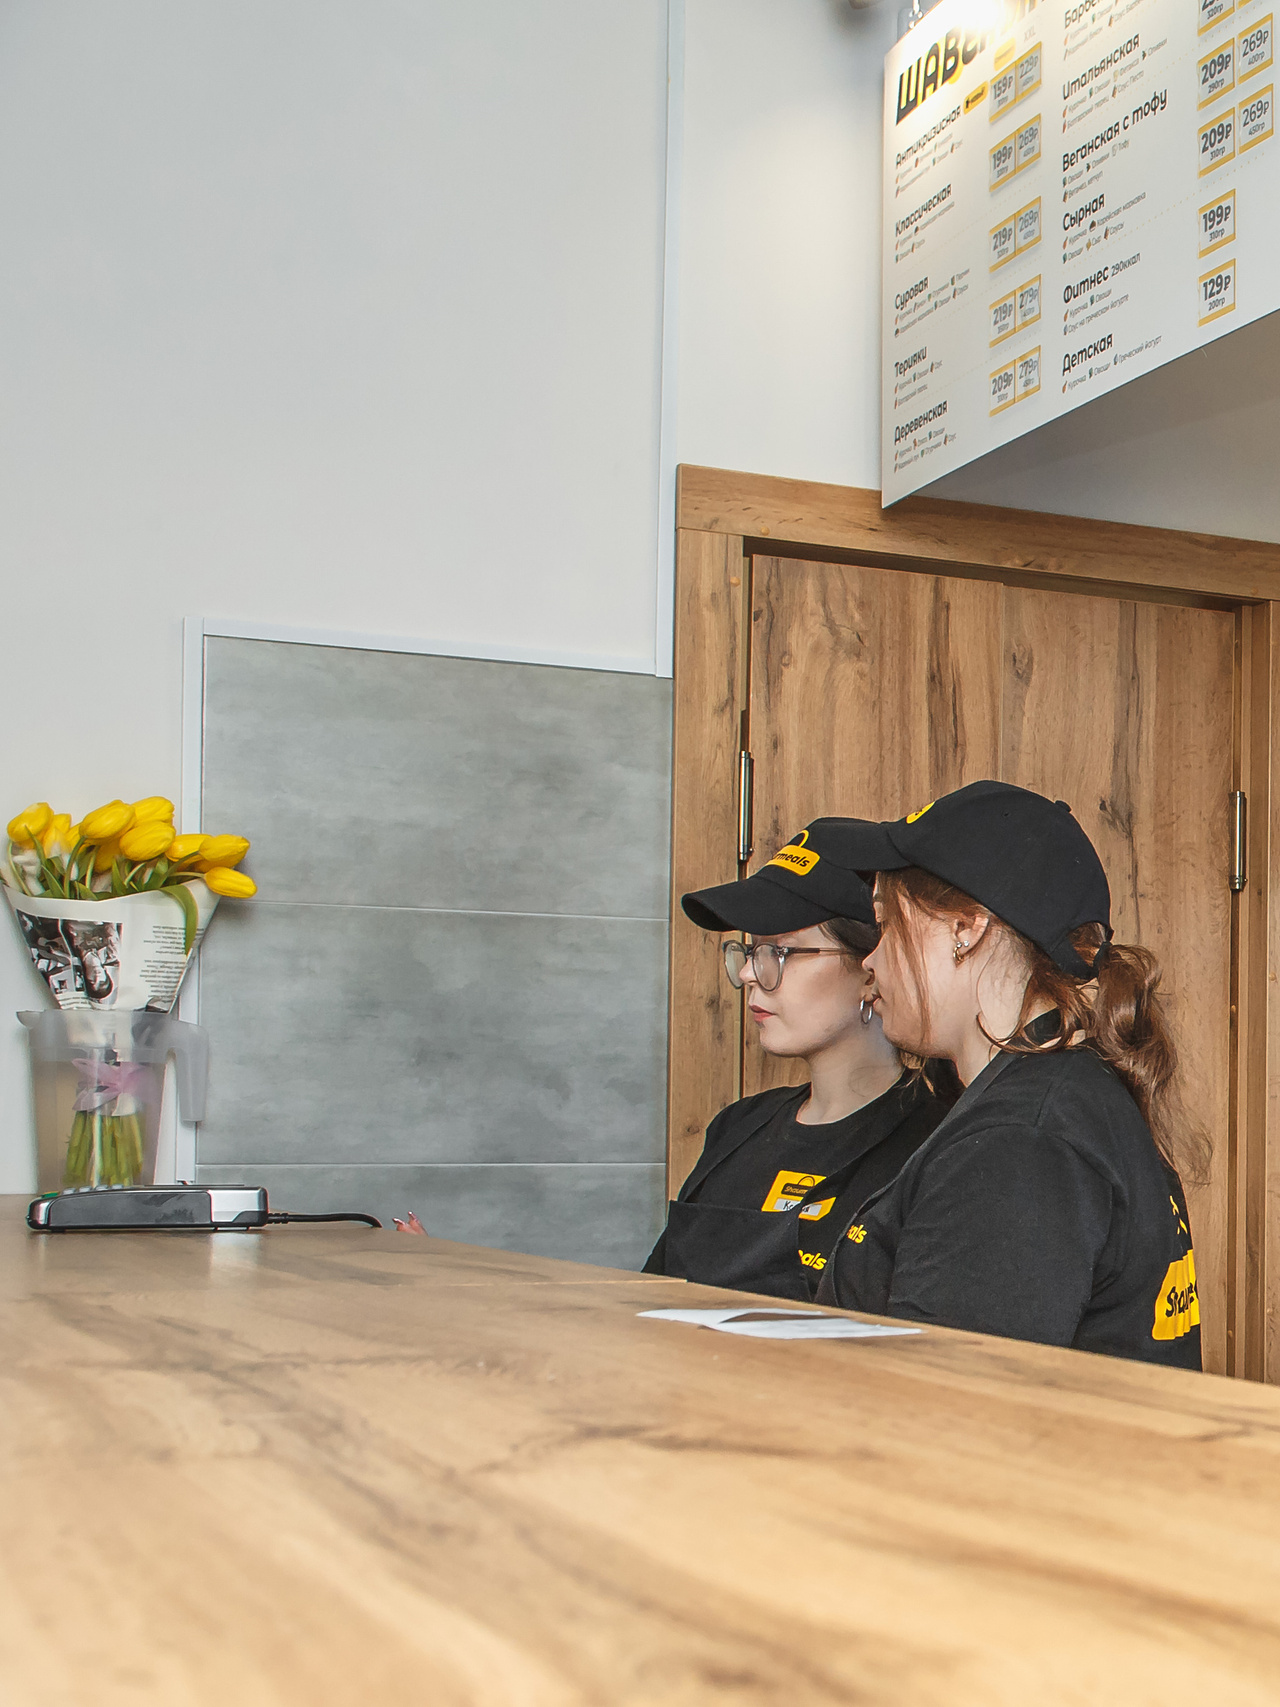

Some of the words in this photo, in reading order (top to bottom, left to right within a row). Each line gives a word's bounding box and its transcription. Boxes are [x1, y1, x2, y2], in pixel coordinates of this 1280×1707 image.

[1063, 33, 1140, 101] Итальянская
[1063, 121, 1120, 172] Веганская
[1123, 115, 1130, 130] с
[1132, 89, 1168, 125] тофу
[896, 183, 952, 237] Классическая
[1063, 193, 1105, 231] Сырная
[895, 276, 928, 311] Суровая
[1064, 266, 1109, 304] Фитнес
[1111, 252, 1141, 277] 290ккал
[895, 347, 927, 377] Терияки
[1063, 333, 1113, 376] Детская
[895, 400, 948, 445] Деревенская
